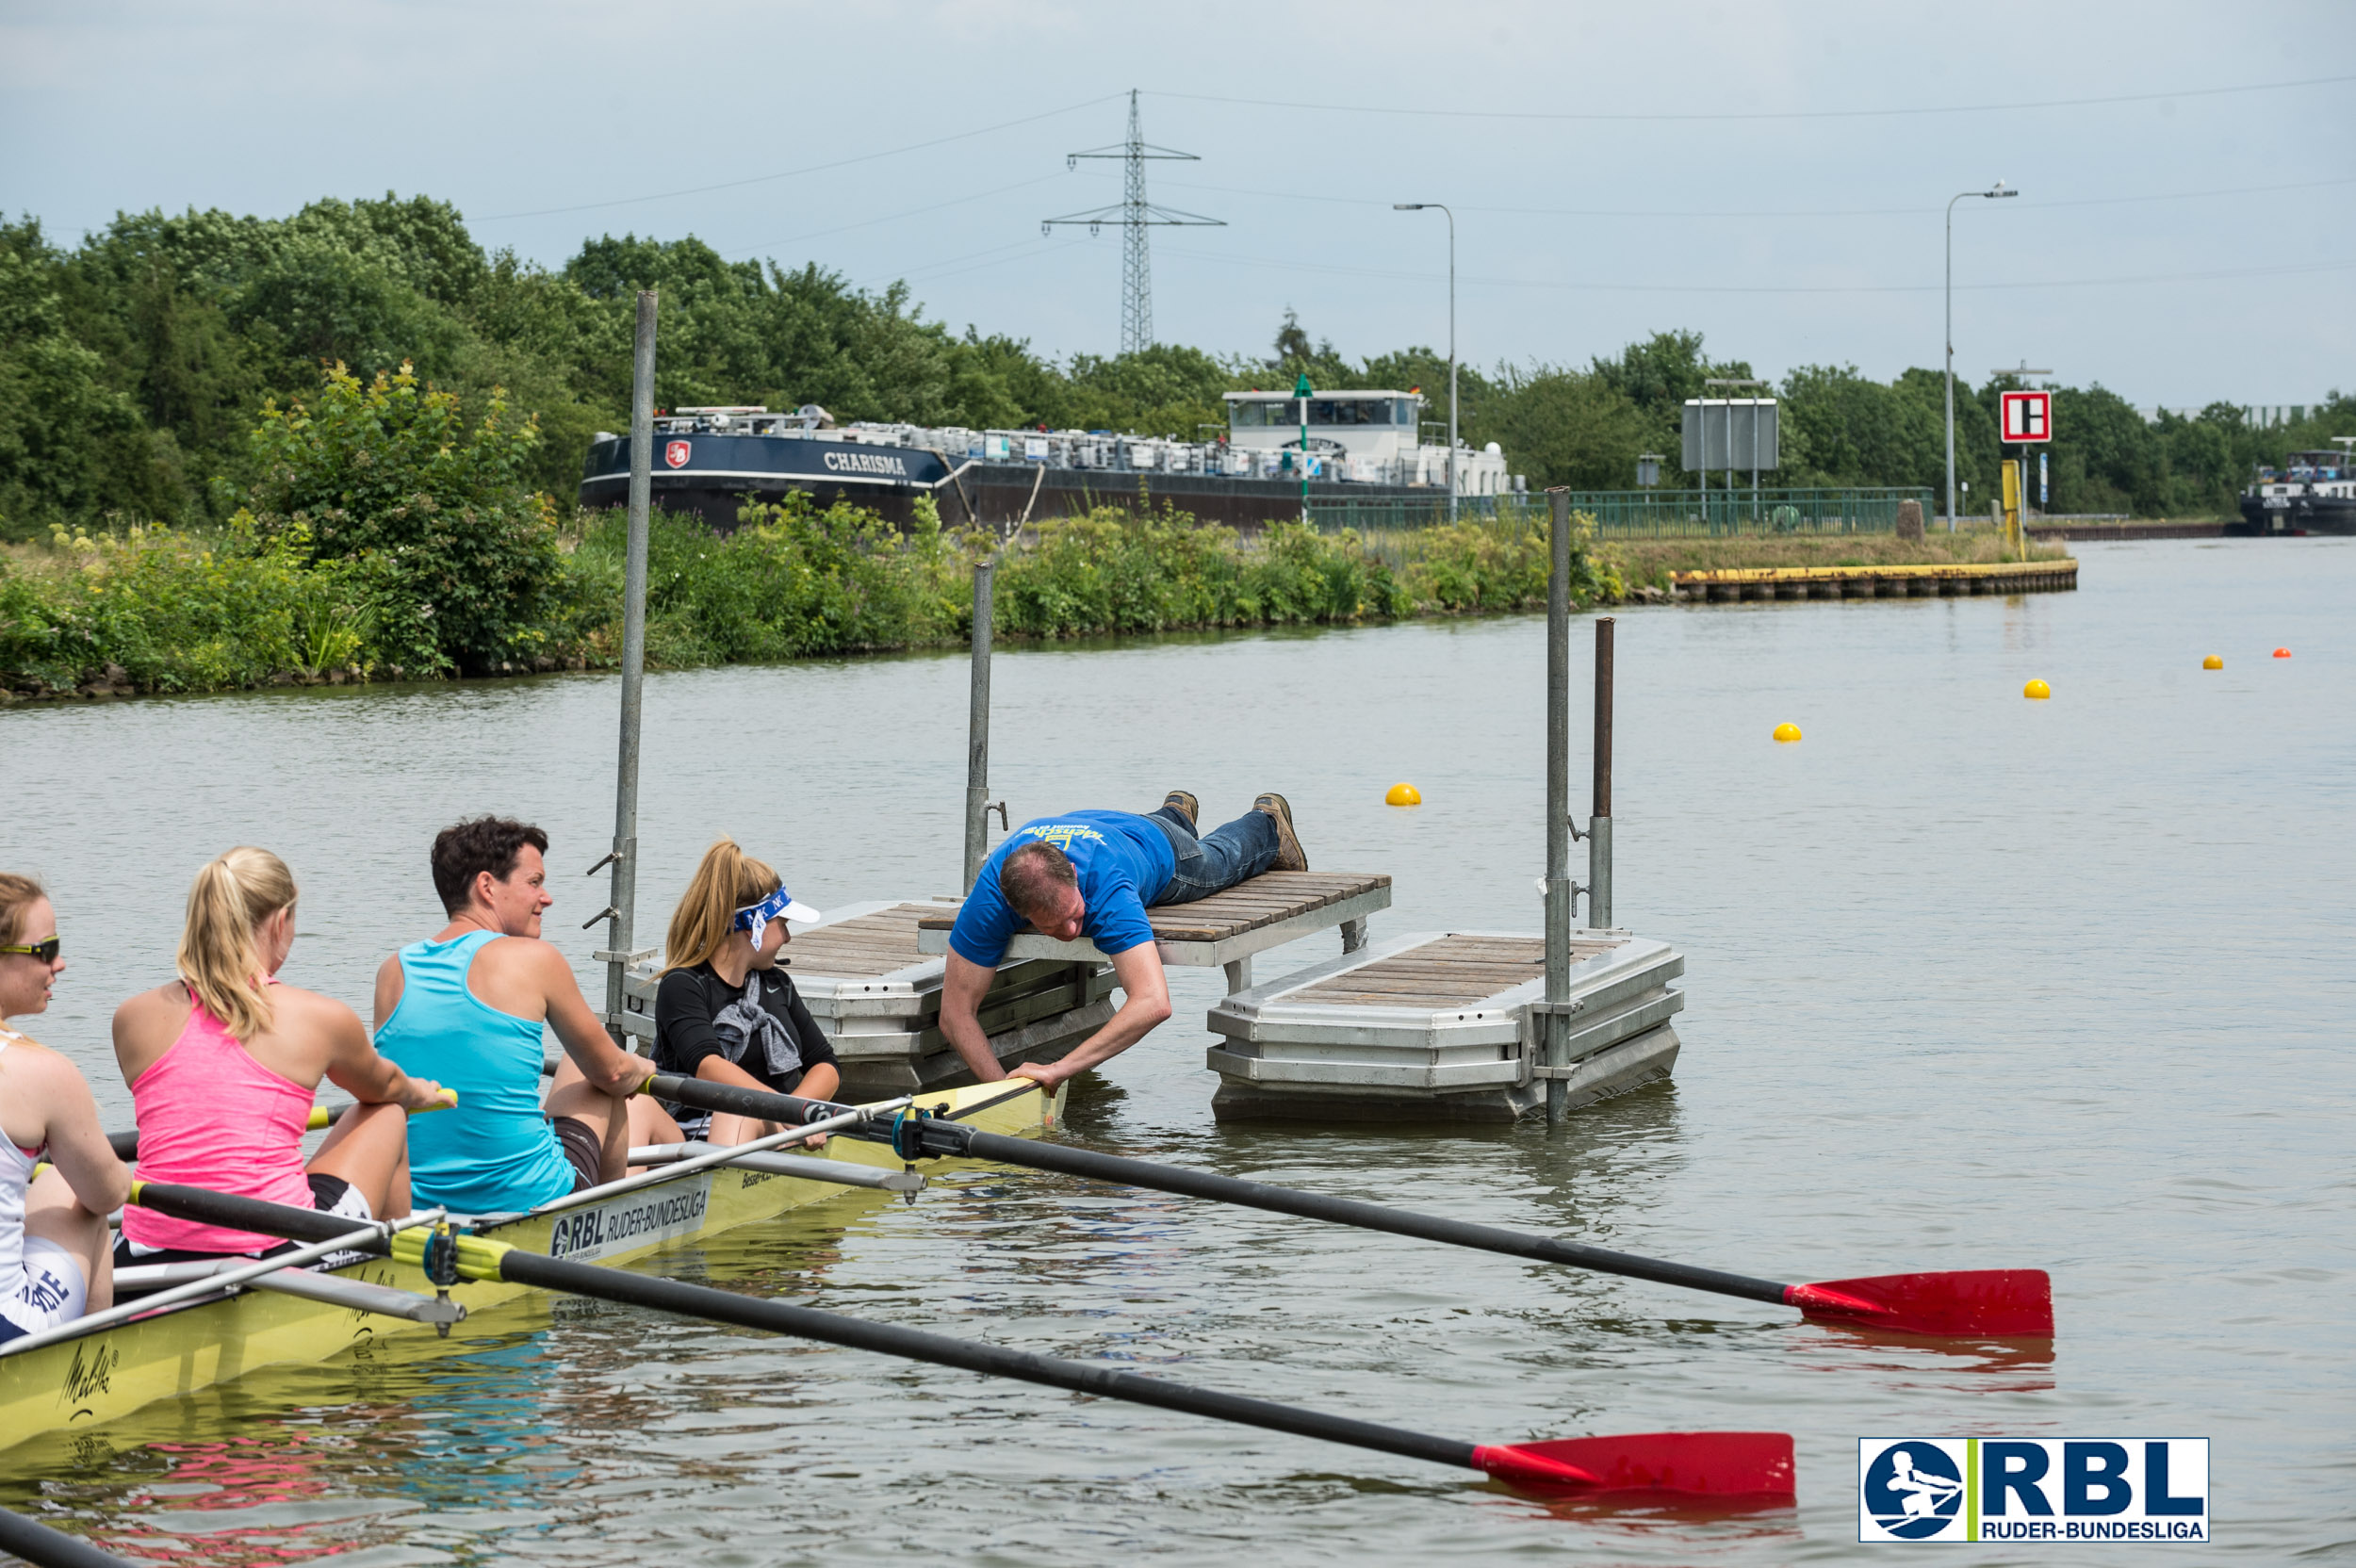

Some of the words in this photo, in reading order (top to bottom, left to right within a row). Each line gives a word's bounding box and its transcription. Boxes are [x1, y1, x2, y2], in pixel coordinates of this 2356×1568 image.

[824, 451, 908, 475] CHARISMA
[772, 894, 785, 910] NK
[569, 1209, 604, 1252] RBL
[606, 1189, 707, 1243] RUDER-BUNDESLIGA
[56, 1341, 112, 1409] Melitta
